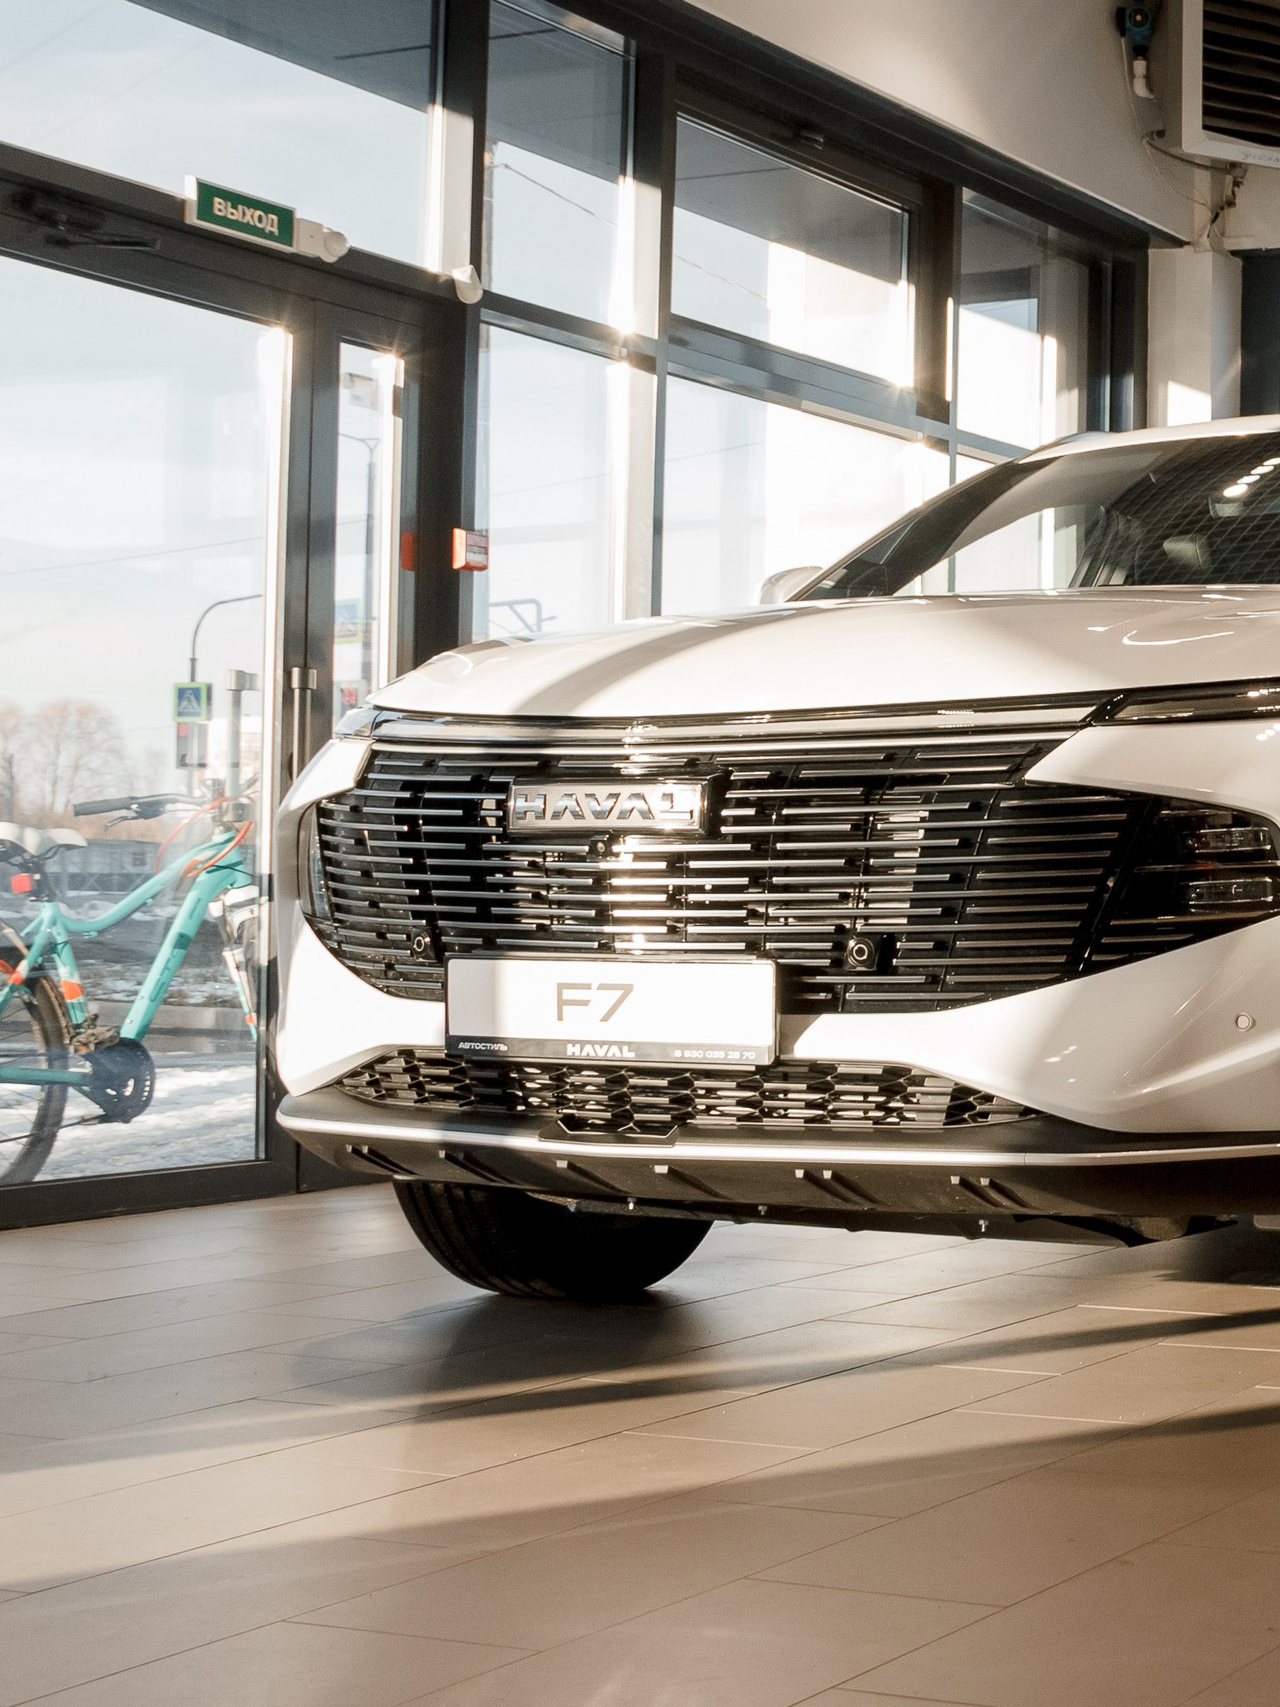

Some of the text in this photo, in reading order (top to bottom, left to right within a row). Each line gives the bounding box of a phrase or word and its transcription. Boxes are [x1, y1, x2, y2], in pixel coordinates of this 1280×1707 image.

[212, 196, 279, 236] ВЫХОД
[514, 792, 694, 821] HAVAL
[556, 982, 634, 1023] F7
[458, 1042, 508, 1051] АВТОСТИЛЬ
[566, 1043, 635, 1058] HAVAL
[683, 1050, 704, 1058] 930
[742, 1051, 756, 1059] 70
